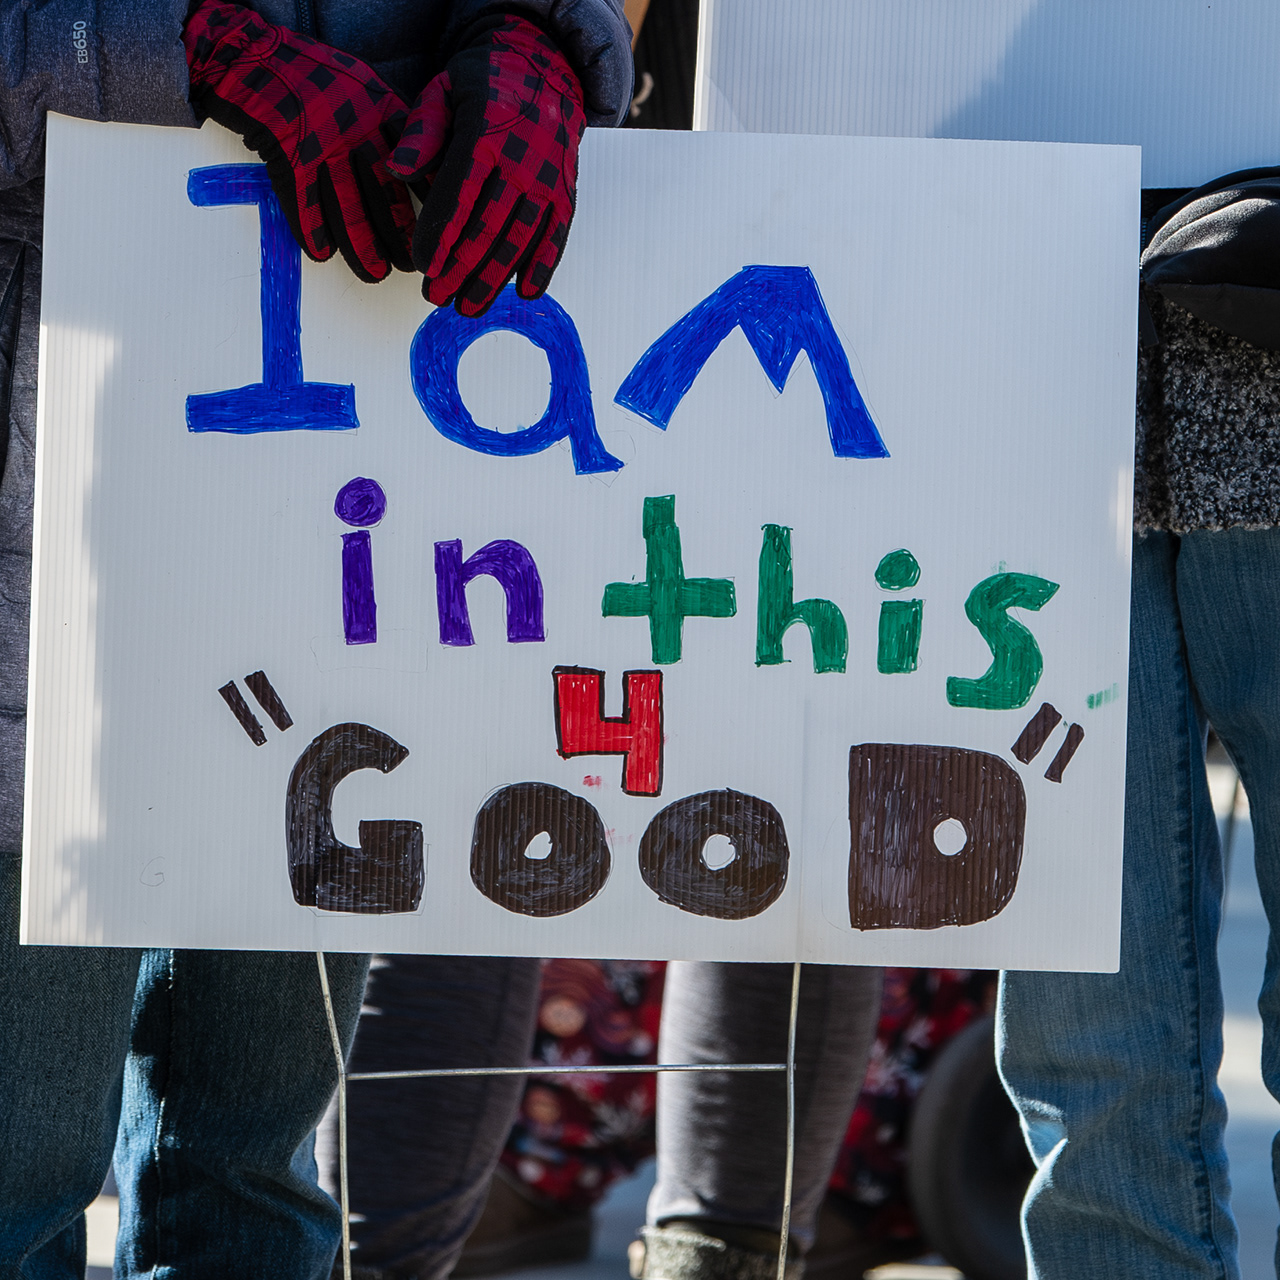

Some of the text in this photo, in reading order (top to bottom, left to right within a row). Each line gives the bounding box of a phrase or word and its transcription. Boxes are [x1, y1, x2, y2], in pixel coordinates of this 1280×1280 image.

[73, 21, 88, 64] EB650
[186, 162, 891, 476] I am
[333, 476, 1060, 711] in this
[217, 670, 1085, 932] "GOOD"
[552, 664, 664, 797] 4
